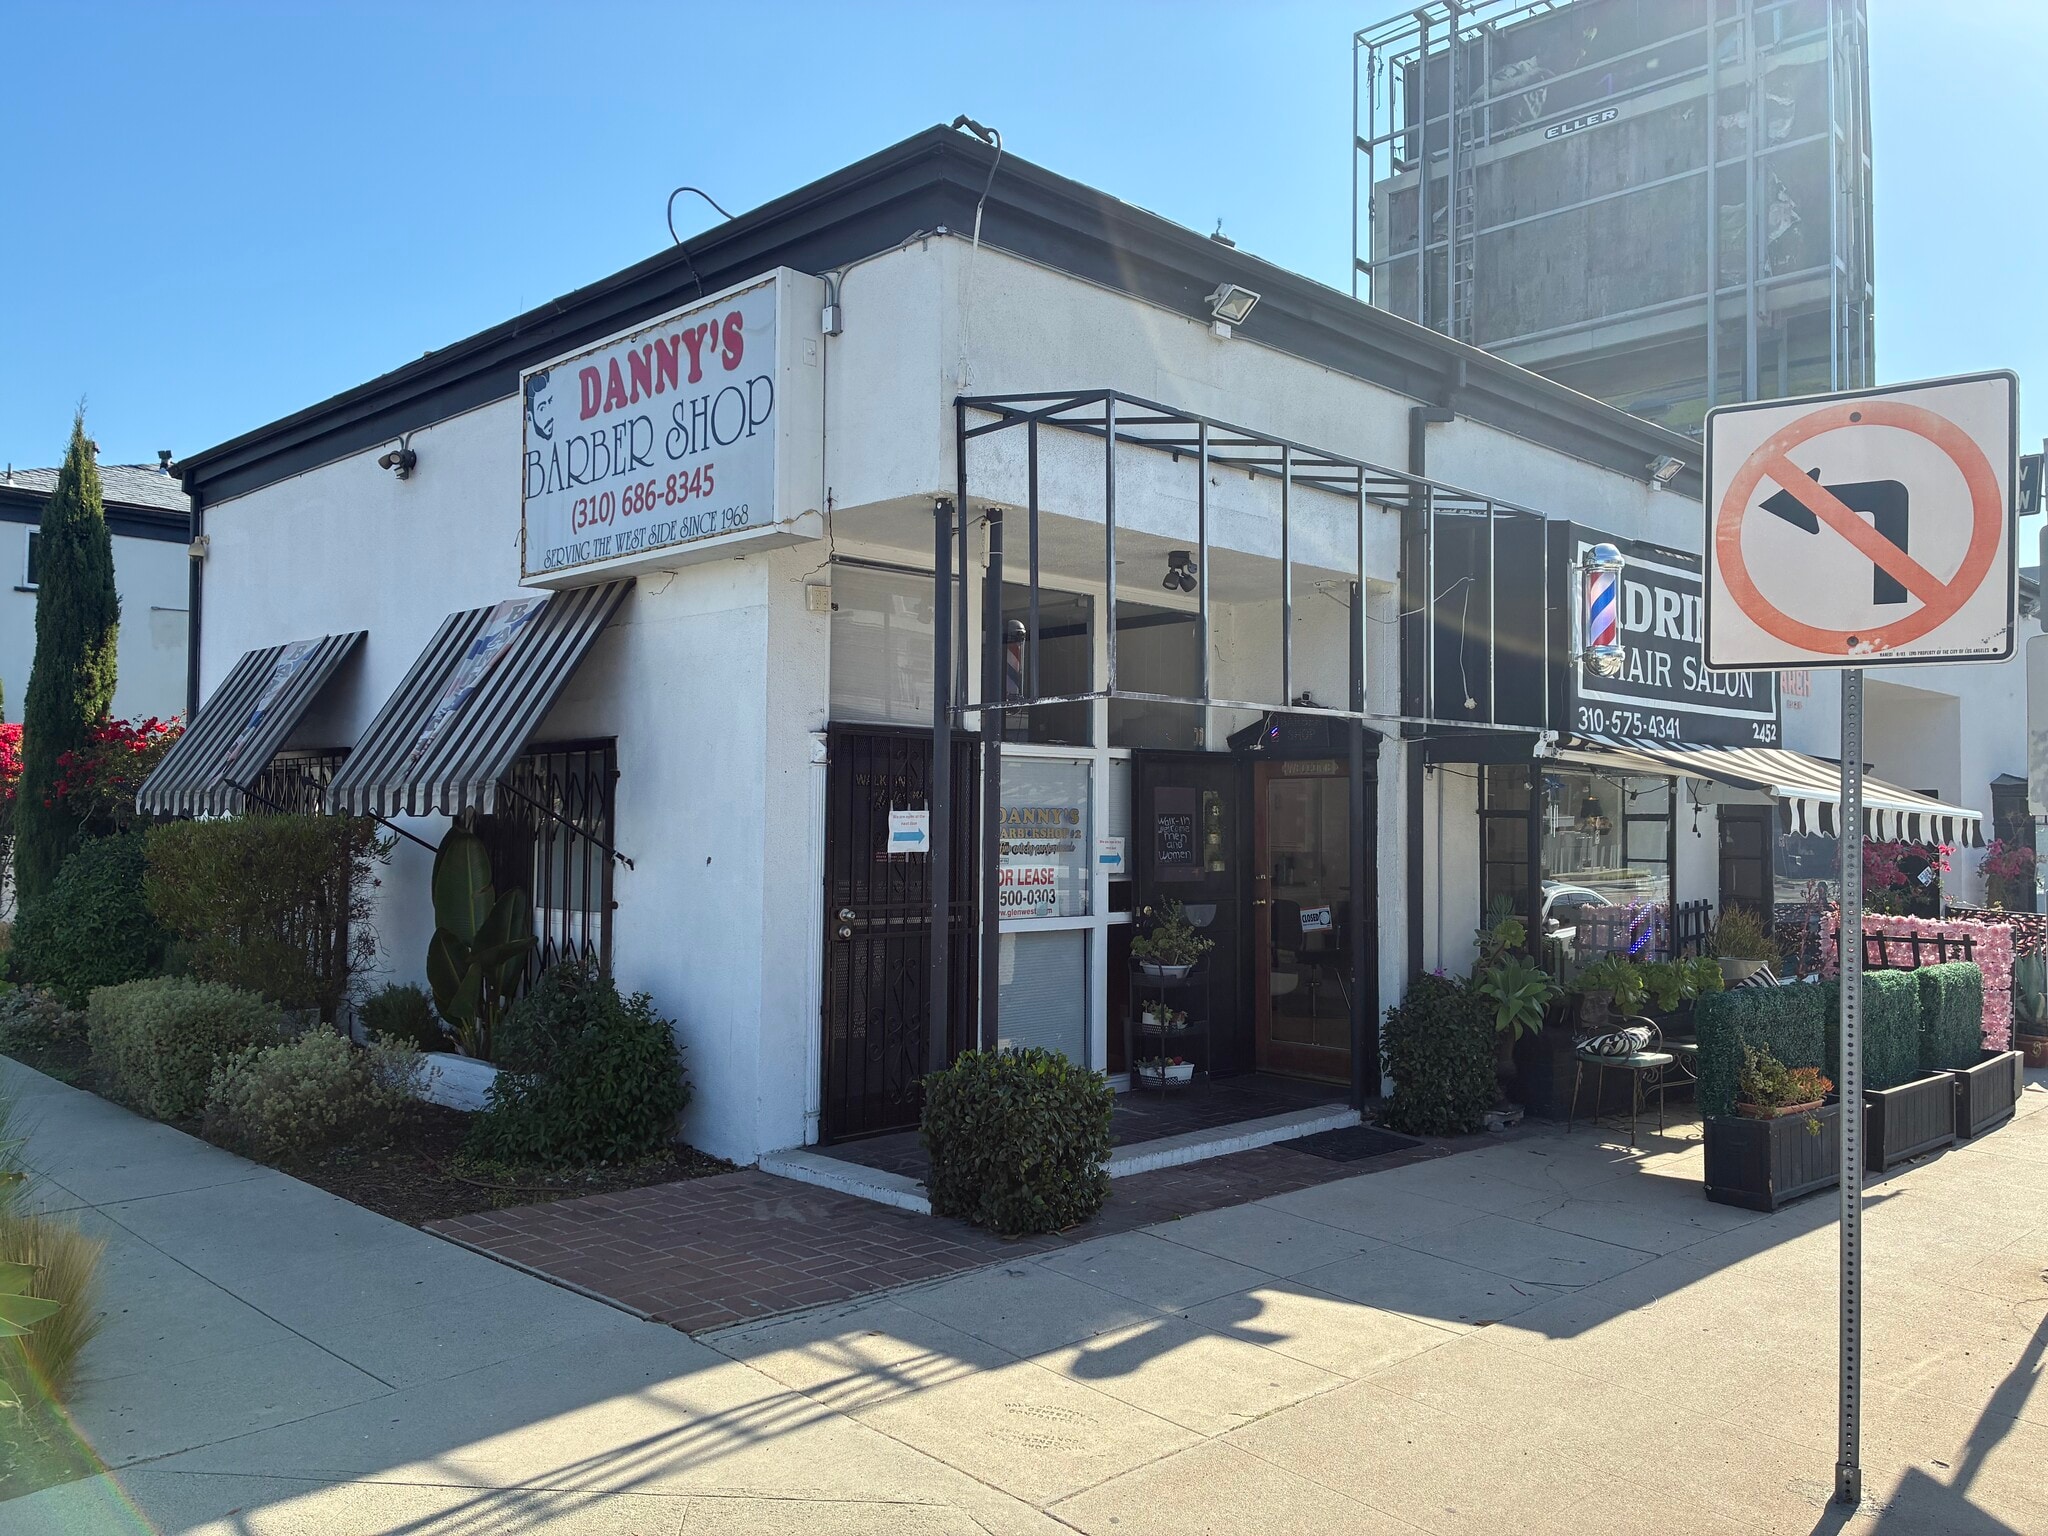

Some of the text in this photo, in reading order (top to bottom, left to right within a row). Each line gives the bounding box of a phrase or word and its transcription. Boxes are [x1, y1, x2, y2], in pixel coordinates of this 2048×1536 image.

[1548, 109, 1616, 138] ELLER
[579, 310, 743, 420] DANNY'S
[525, 375, 774, 500] BARBER SHOP
[572, 464, 714, 534] (310) 686-8345
[544, 504, 749, 568] SERVING THE WEST SIDE SINCE 1968
[1615, 579, 1702, 644] DRI
[1683, 656, 1754, 698] SALON
[1752, 722, 1776, 742] 2452
[999, 868, 1054, 886] OR LEASE
[1302, 913, 1319, 923] CLOSED
